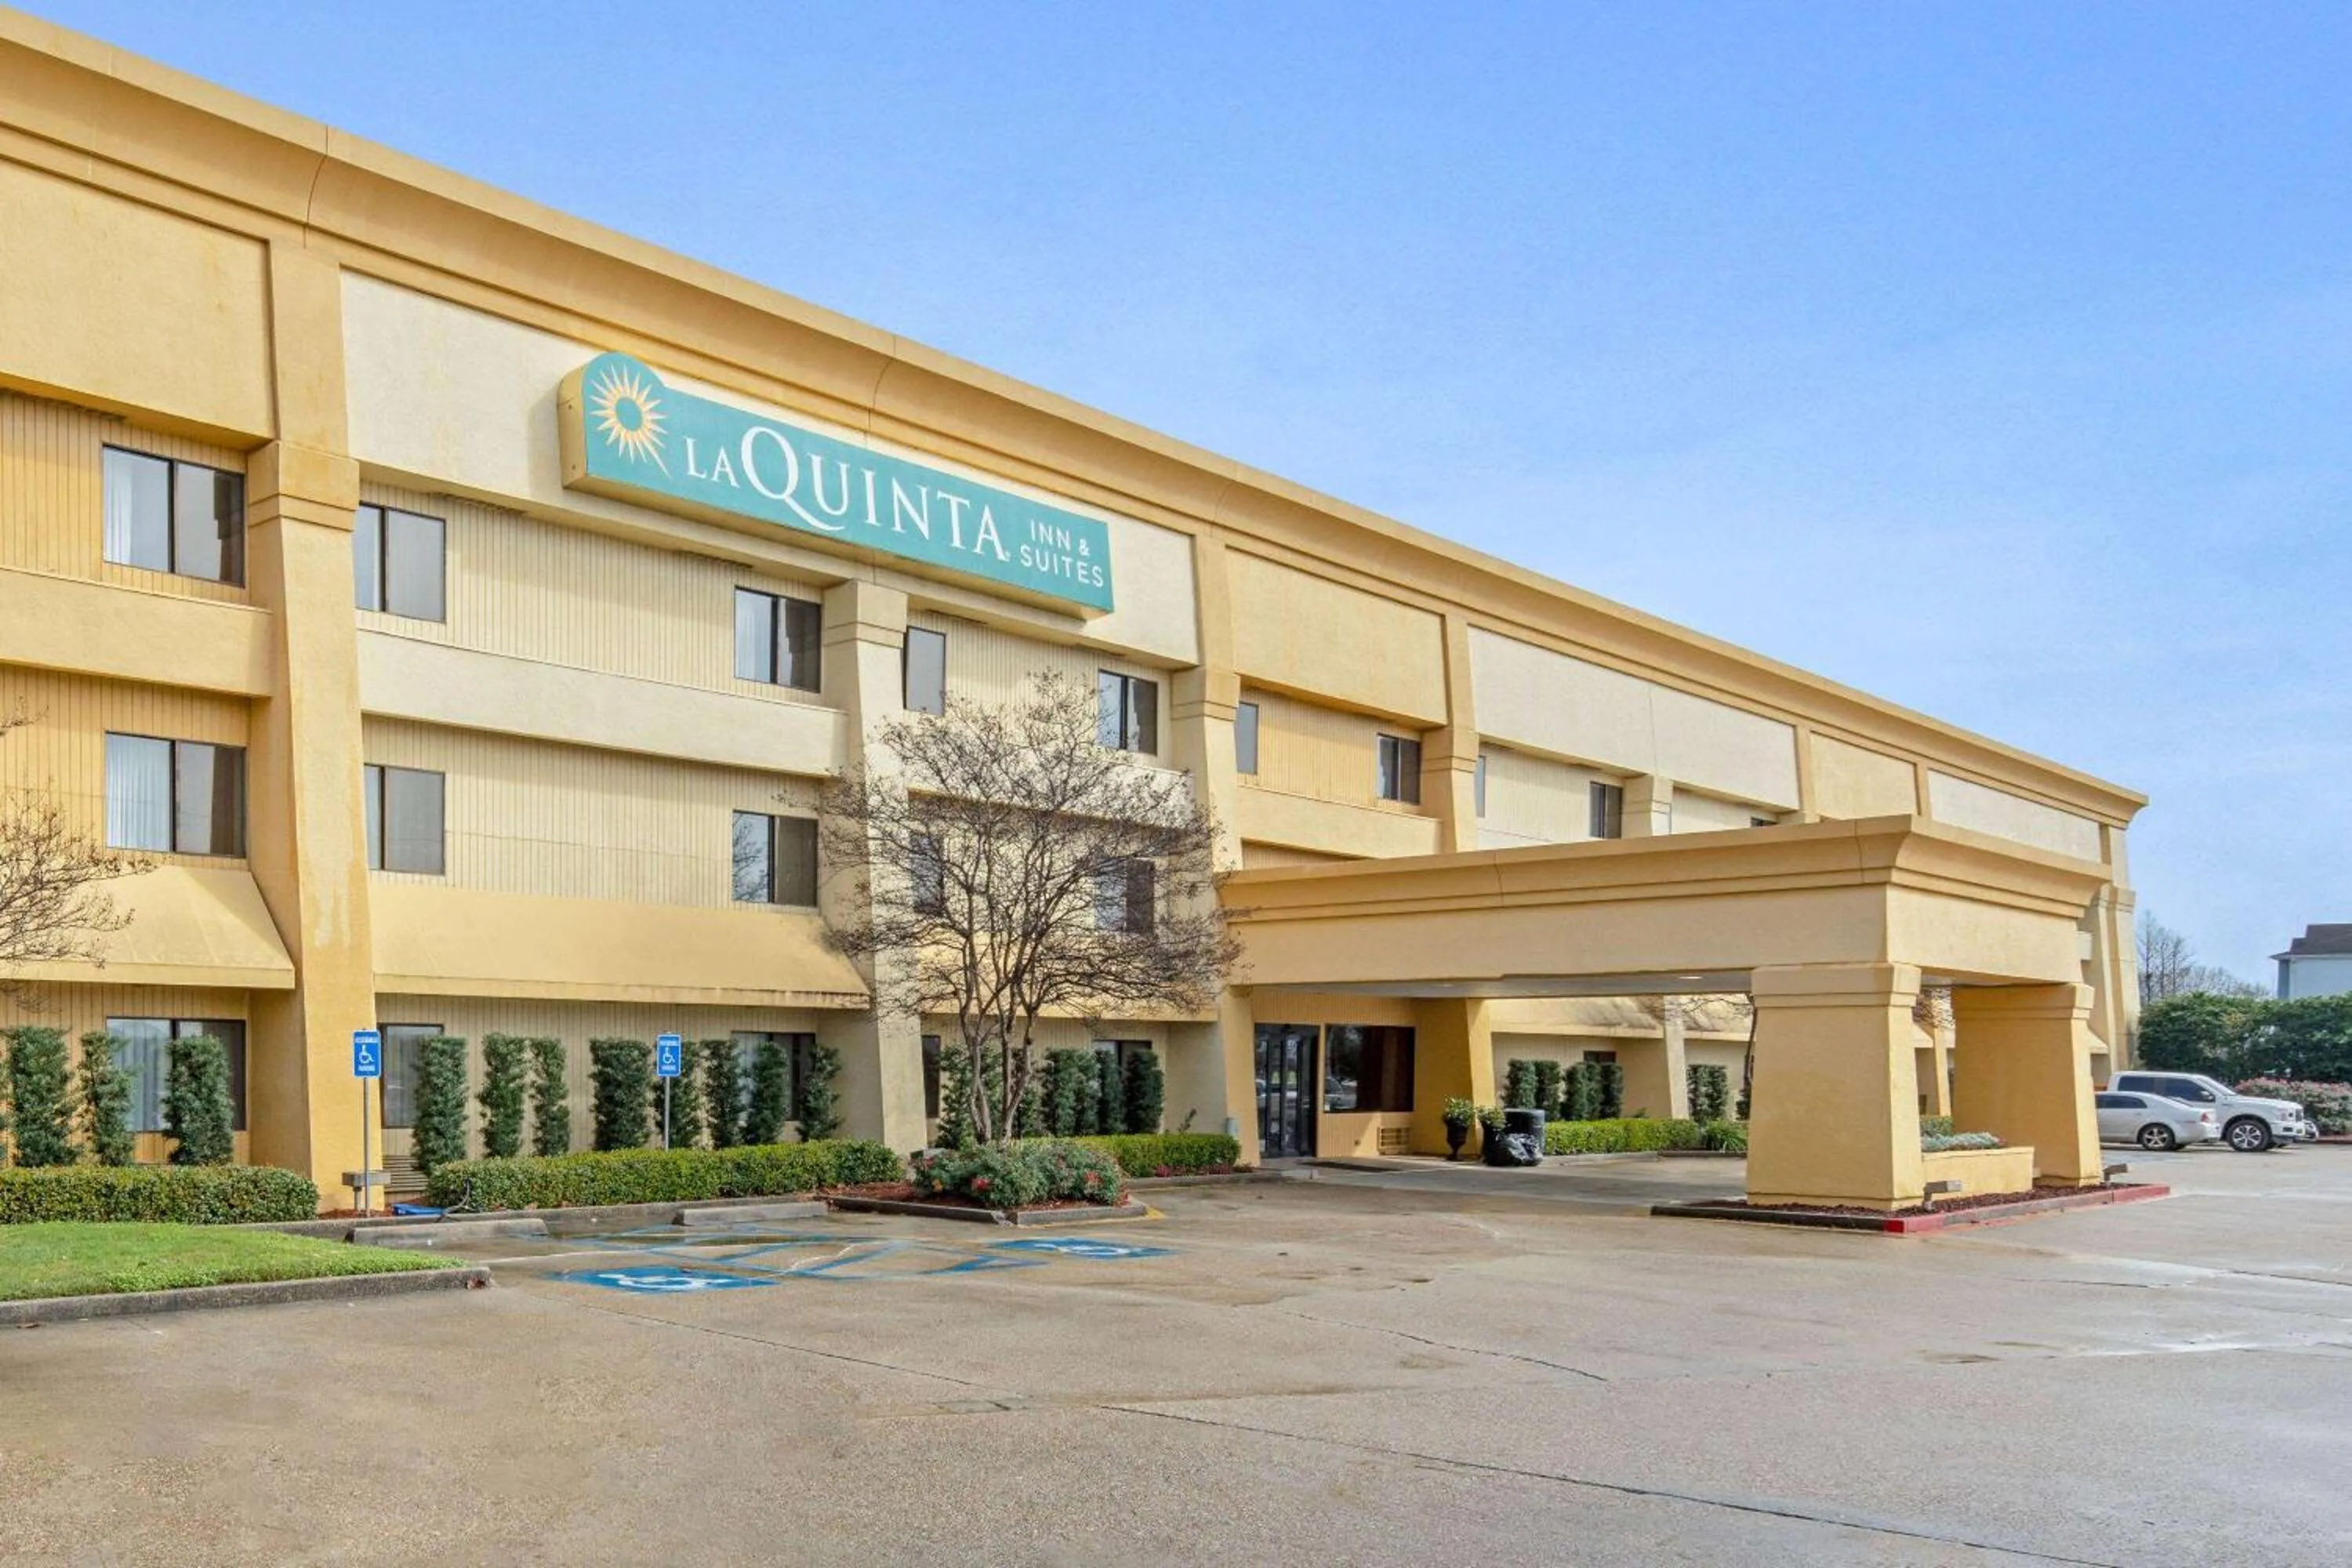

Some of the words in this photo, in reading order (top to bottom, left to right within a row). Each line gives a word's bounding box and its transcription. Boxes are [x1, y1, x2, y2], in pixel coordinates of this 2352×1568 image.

[684, 436, 740, 488] LA
[741, 426, 1007, 561] QUINTA
[1030, 519, 1071, 551] INN
[1078, 538, 1091, 556] &
[1020, 543, 1104, 587] SUITES
